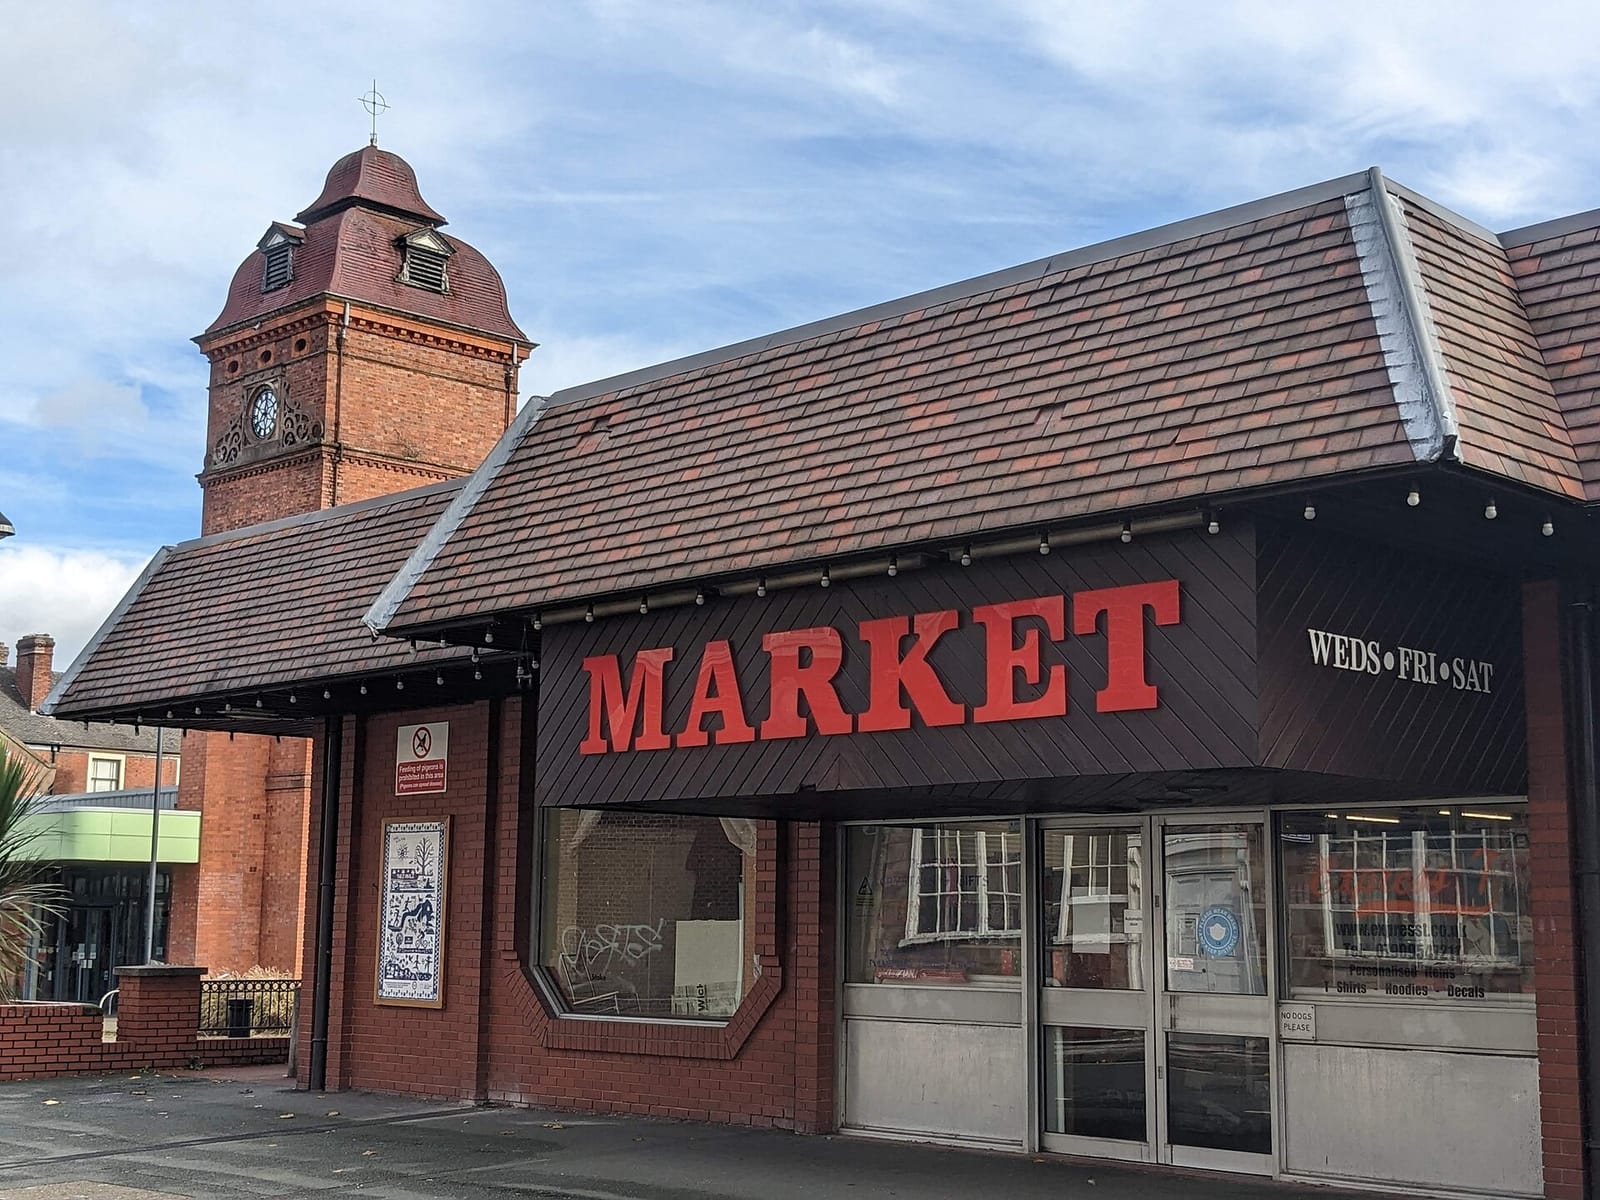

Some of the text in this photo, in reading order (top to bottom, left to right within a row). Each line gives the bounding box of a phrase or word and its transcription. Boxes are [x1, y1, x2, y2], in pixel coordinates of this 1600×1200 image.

[580, 579, 1181, 755] MARKET
[422, 763, 439, 773] pigeons
[1350, 963, 1456, 980] Personalised Items
[1323, 980, 1329, 993] T
[1336, 980, 1367, 994] Shirts
[1385, 982, 1429, 996] Hoodies
[1447, 984, 1485, 999] Decals
[1281, 1011, 1313, 1021] NO DOGS
[1283, 1022, 1311, 1032] PLEASE
